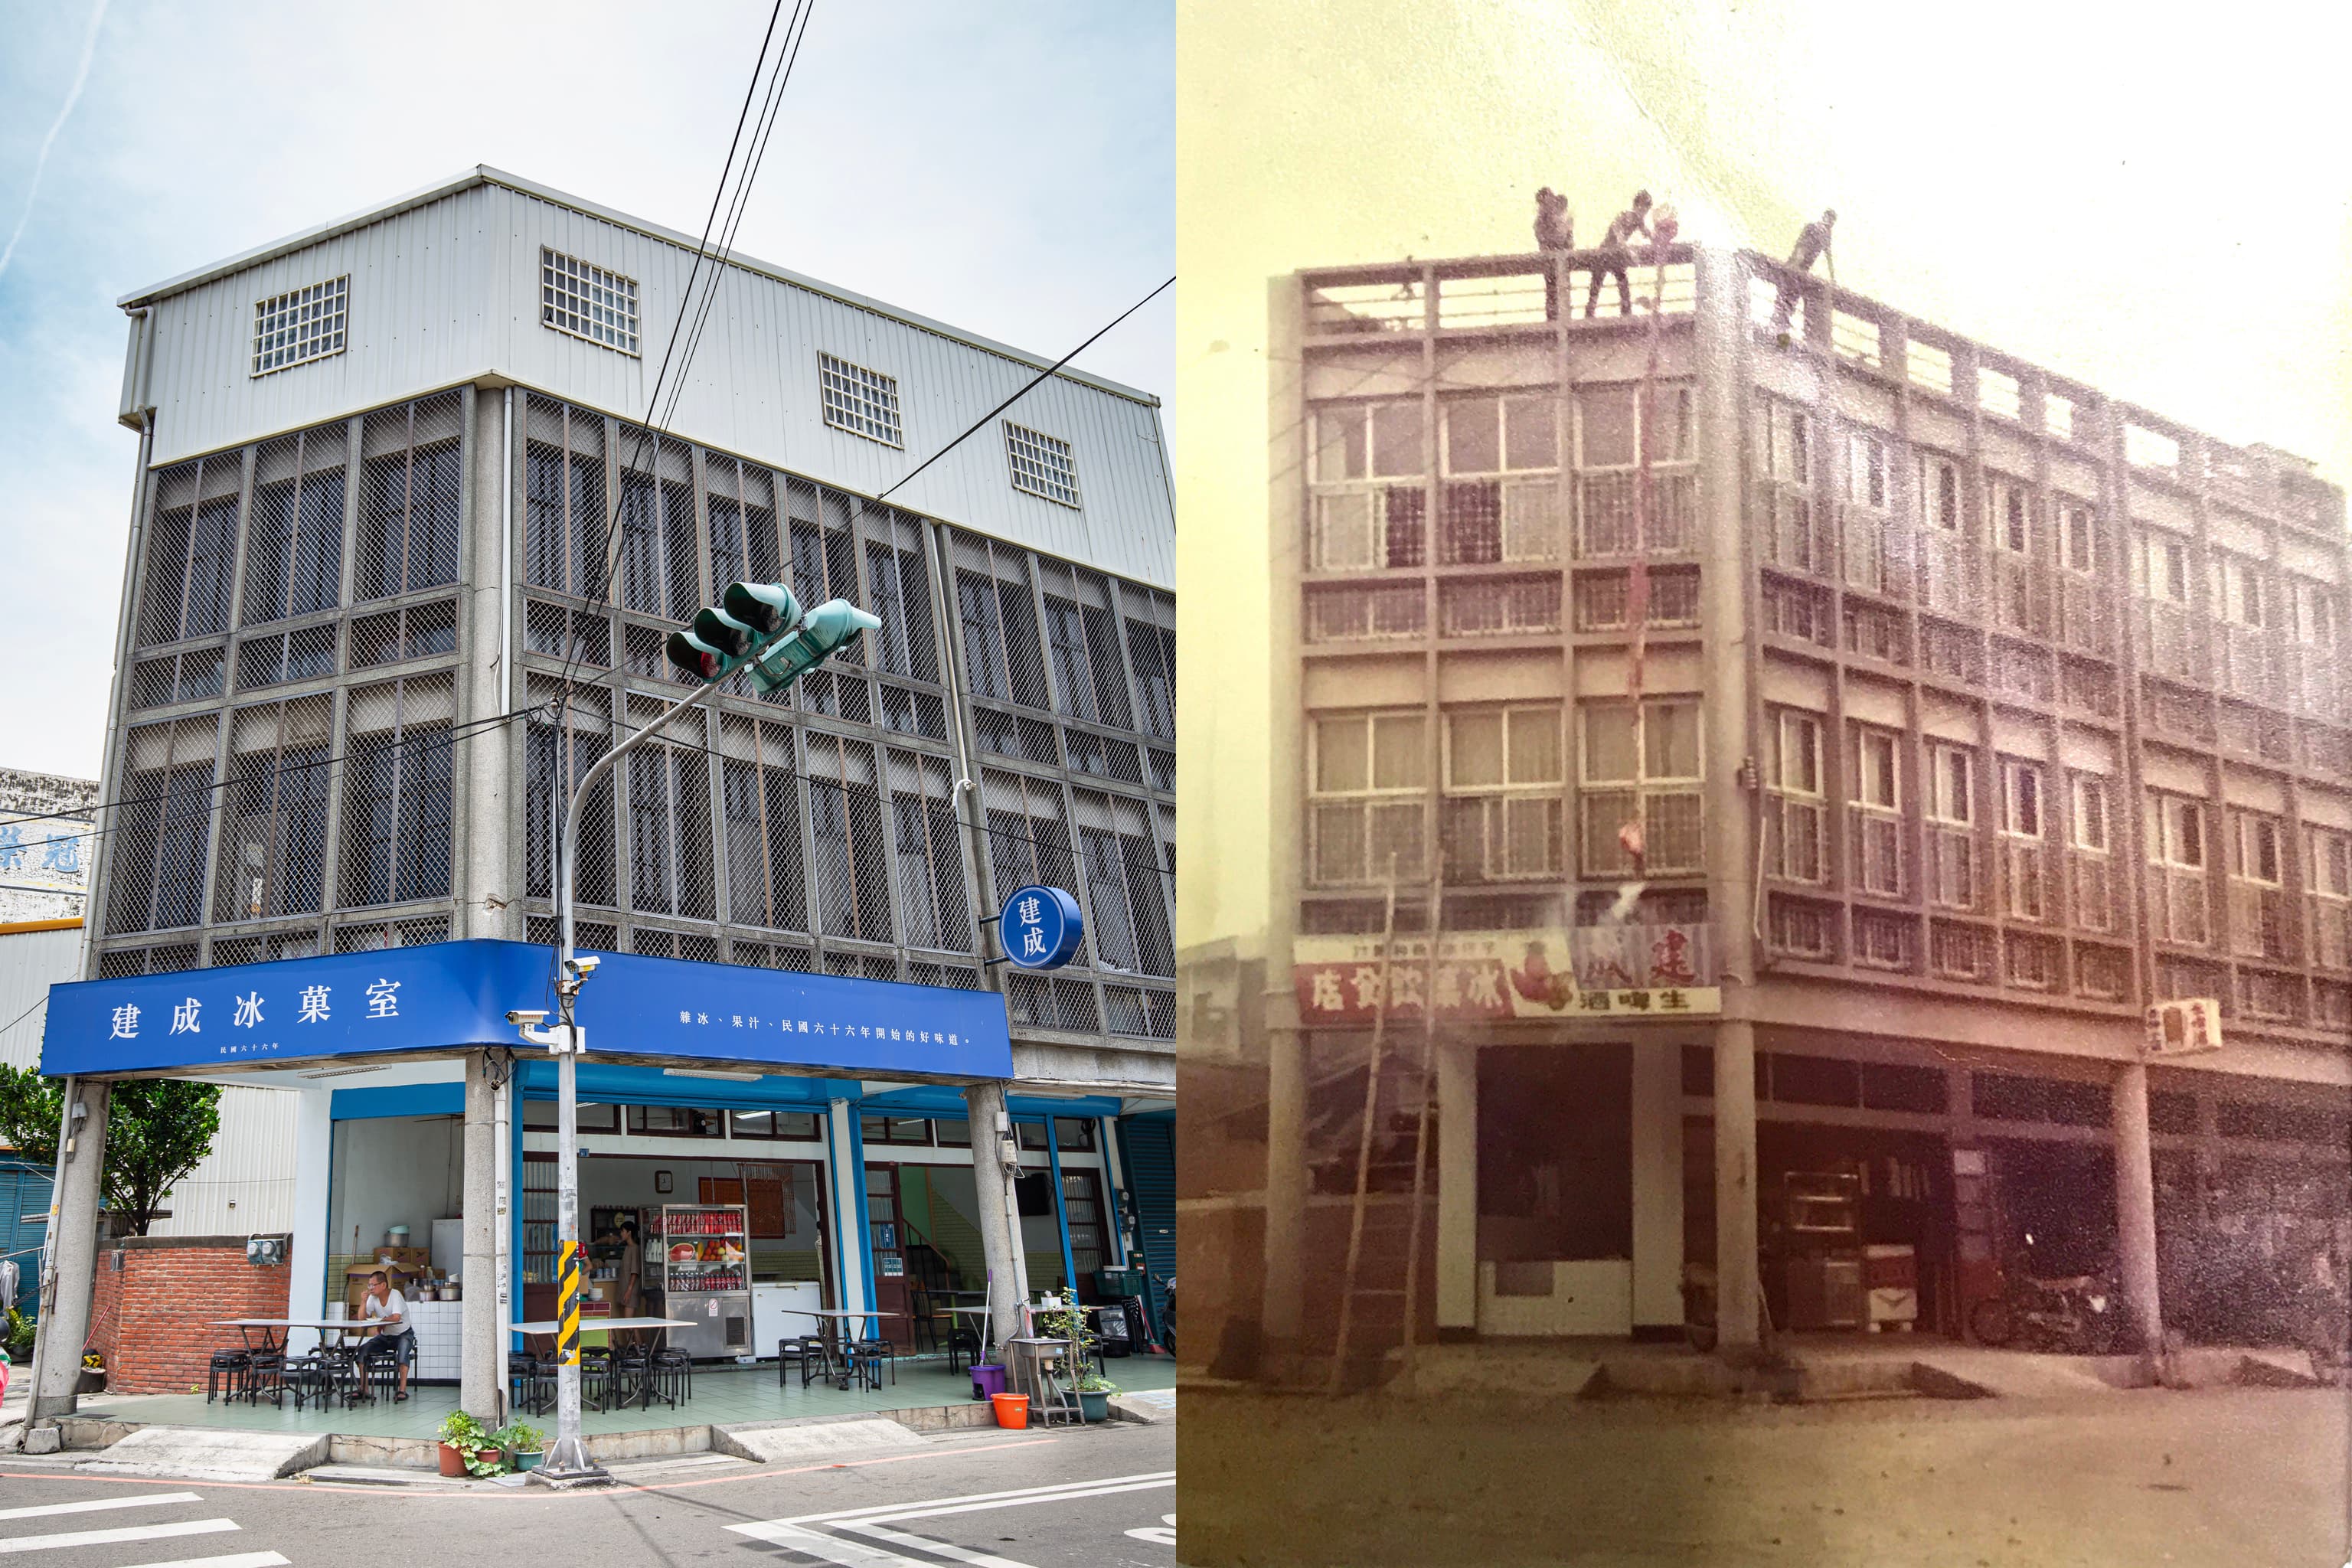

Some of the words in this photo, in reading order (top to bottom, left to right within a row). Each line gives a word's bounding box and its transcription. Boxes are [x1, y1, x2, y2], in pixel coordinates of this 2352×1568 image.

[1017, 897, 1047, 959] 建成
[109, 978, 401, 1040] 建成冰菓室
[220, 1042, 279, 1054] 民國六十六年
